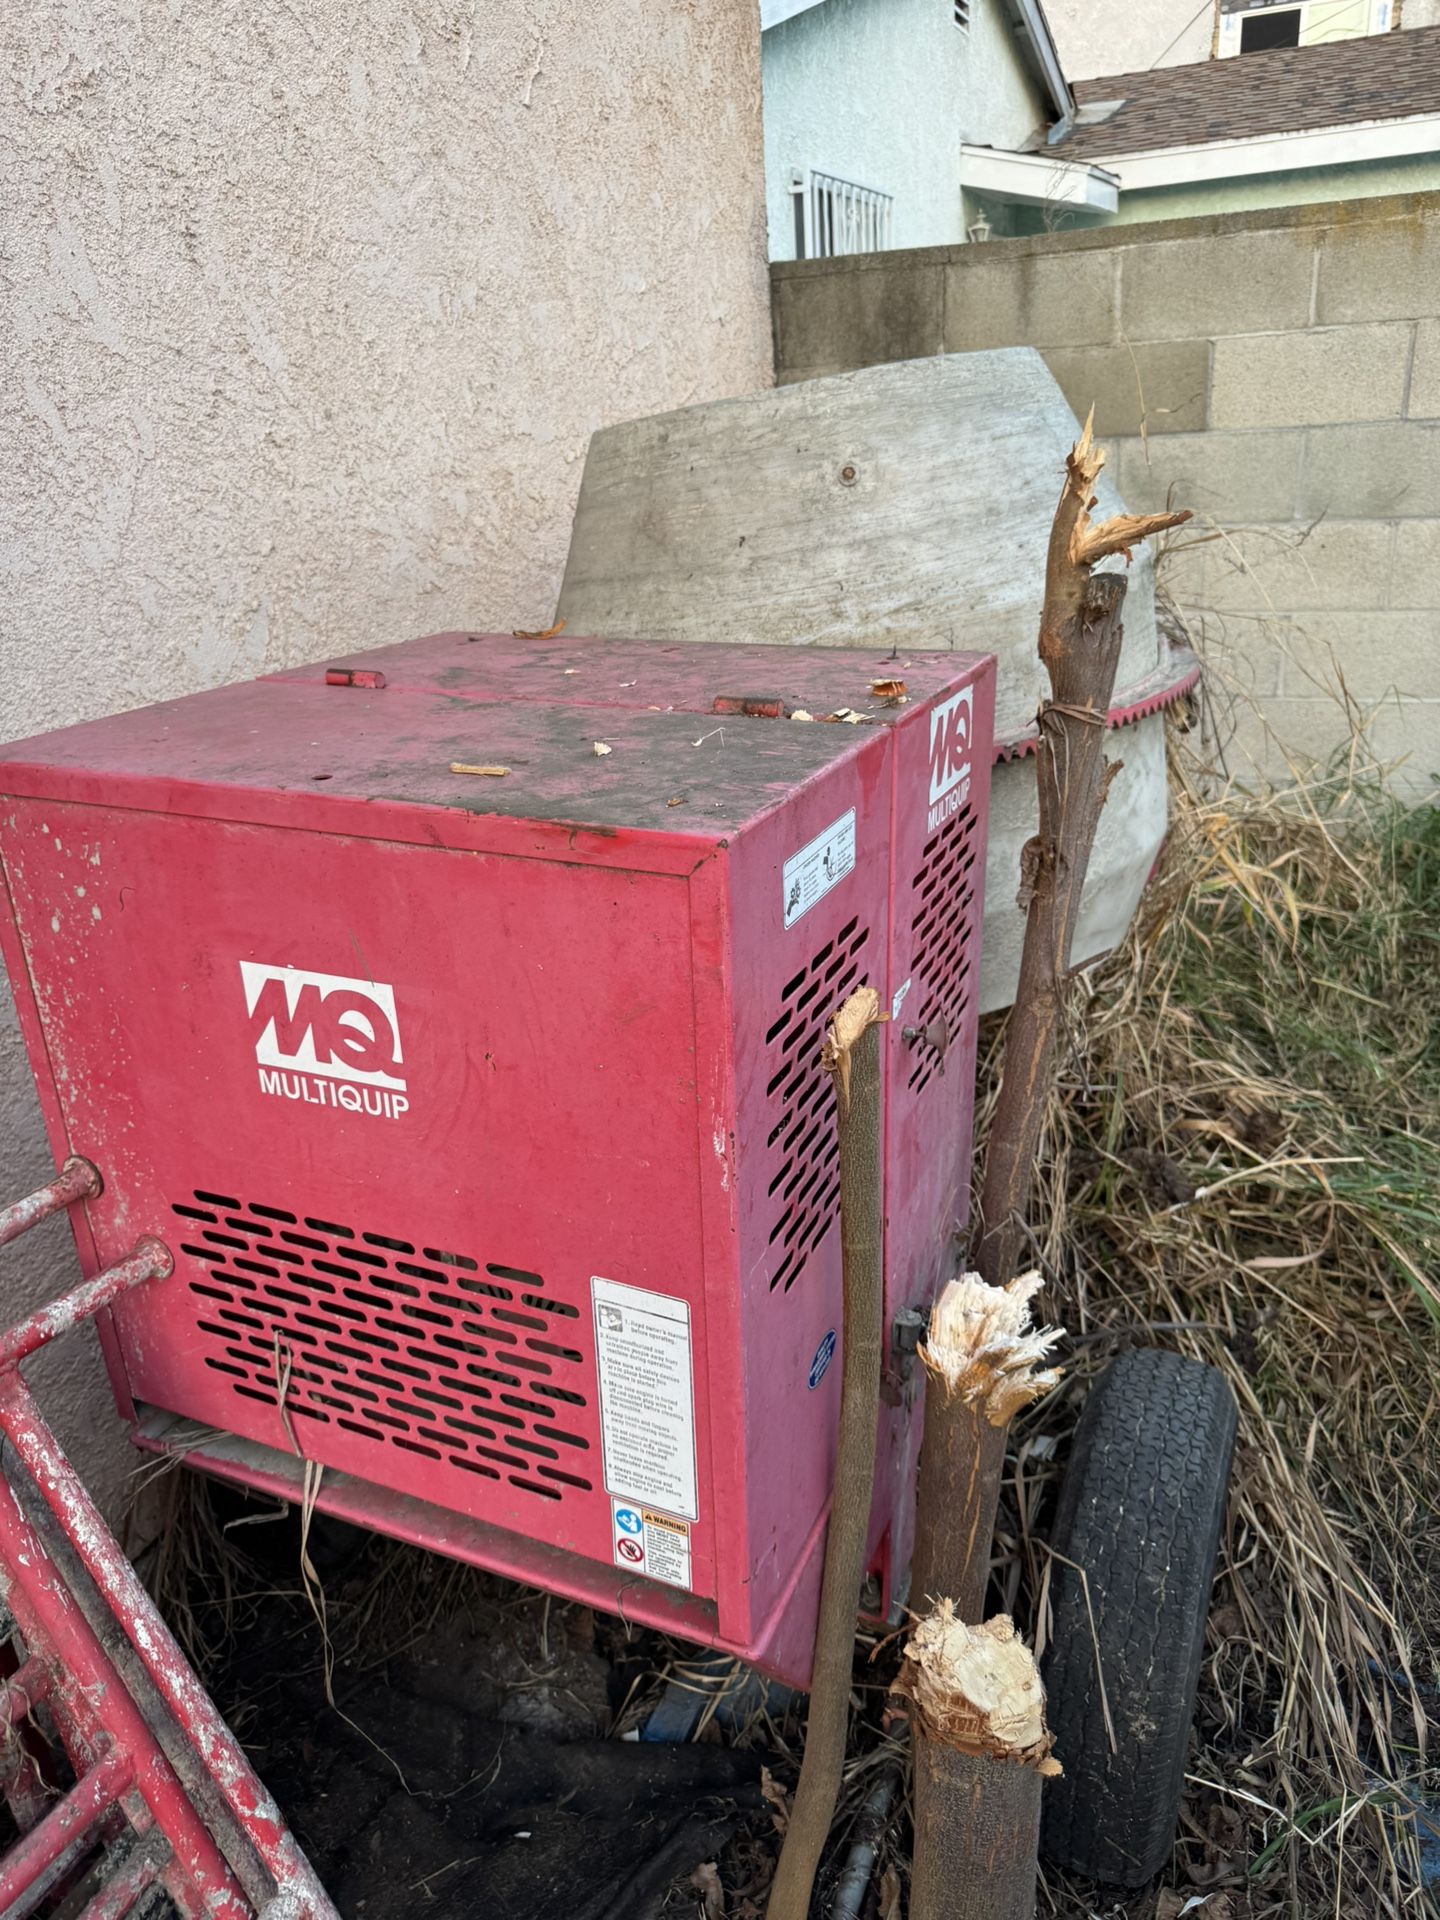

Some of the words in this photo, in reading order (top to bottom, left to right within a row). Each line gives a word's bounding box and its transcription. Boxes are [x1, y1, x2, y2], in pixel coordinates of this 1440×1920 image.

[928, 777, 971, 834] MULTIQUIP
[246, 973, 406, 1085] MQ
[258, 1068, 410, 1120] MULTIQUIP
[653, 1514, 686, 1533] WARNING
